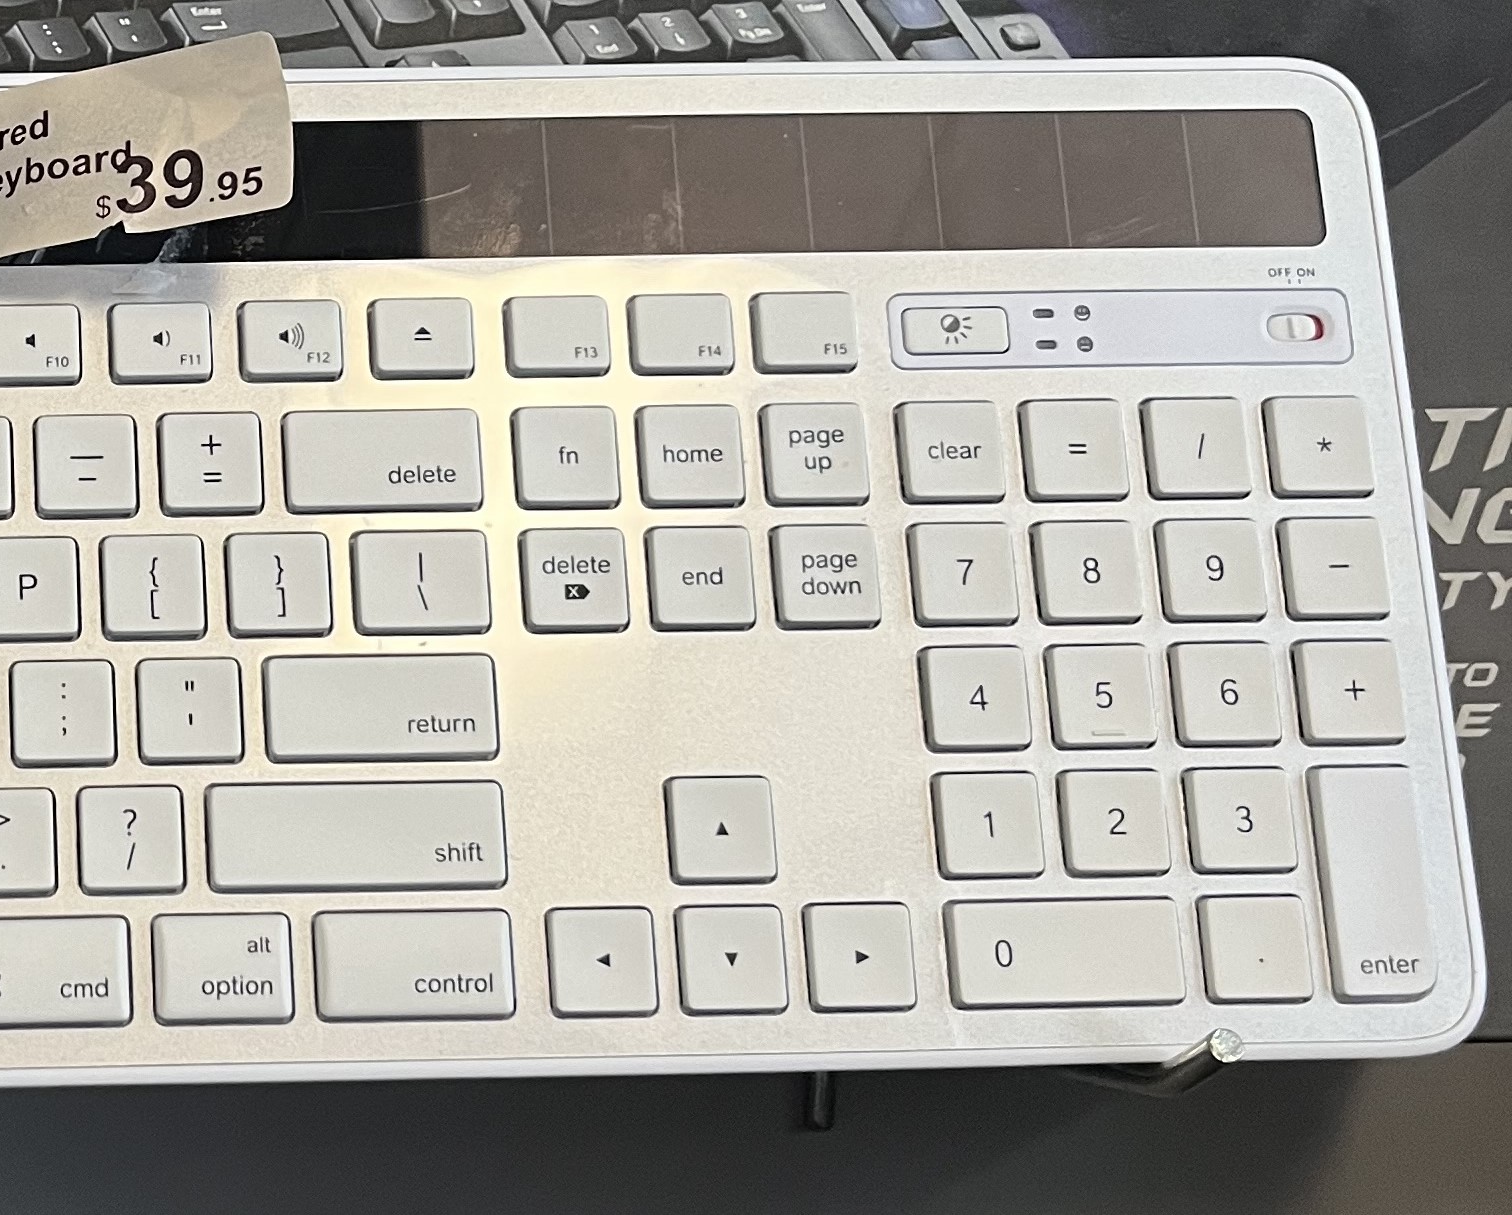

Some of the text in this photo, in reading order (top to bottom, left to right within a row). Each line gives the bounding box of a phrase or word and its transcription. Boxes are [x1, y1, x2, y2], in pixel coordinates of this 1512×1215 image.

[661, 16, 675, 28] 2
[1268, 268, 1315, 277] OFF ON
[306, 351, 331, 364] F12
[574, 346, 599, 359] F13
[698, 345, 722, 357] F14
[823, 342, 848, 355] F15
[45, 355, 70, 368] F10
[180, 353, 201, 366] F11
[200, 434, 222, 456] +
[788, 428, 845, 449] page
[1068, 443, 1088, 455] =
[558, 445, 579, 465] fn
[662, 444, 724, 463] home
[928, 441, 982, 460] clear
[388, 464, 457, 485] delete
[804, 455, 833, 474] up
[203, 471, 223, 484] =
[147, 556, 160, 588] {
[273, 554, 285, 587] }
[542, 555, 611, 575] delete
[801, 553, 858, 574] page
[956, 558, 974, 586] 7
[1082, 557, 1101, 584] 8
[1205, 554, 1225, 582] 9
[682, 566, 724, 586] end
[801, 576, 862, 596] down
[18, 573, 38, 601] P
[416, 584, 429, 611] \
[149, 588, 162, 620] [
[275, 586, 288, 618] ]
[183, 680, 196, 692] "
[1095, 681, 1113, 709] 5
[1220, 678, 1239, 706] 6
[1344, 679, 1366, 701] +
[969, 684, 989, 712] 4
[407, 714, 476, 734] return
[122, 808, 137, 837] ?
[982, 810, 995, 838] 1
[1108, 807, 1128, 835] 2
[1235, 805, 1254, 833] 3
[125, 842, 138, 871] /
[434, 841, 484, 863] shift
[247, 936, 272, 954] alt
[994, 939, 1013, 968] 0
[1360, 954, 1420, 975] enter
[60, 977, 109, 999] cmd
[201, 975, 273, 1001] option
[414, 972, 494, 994] control
